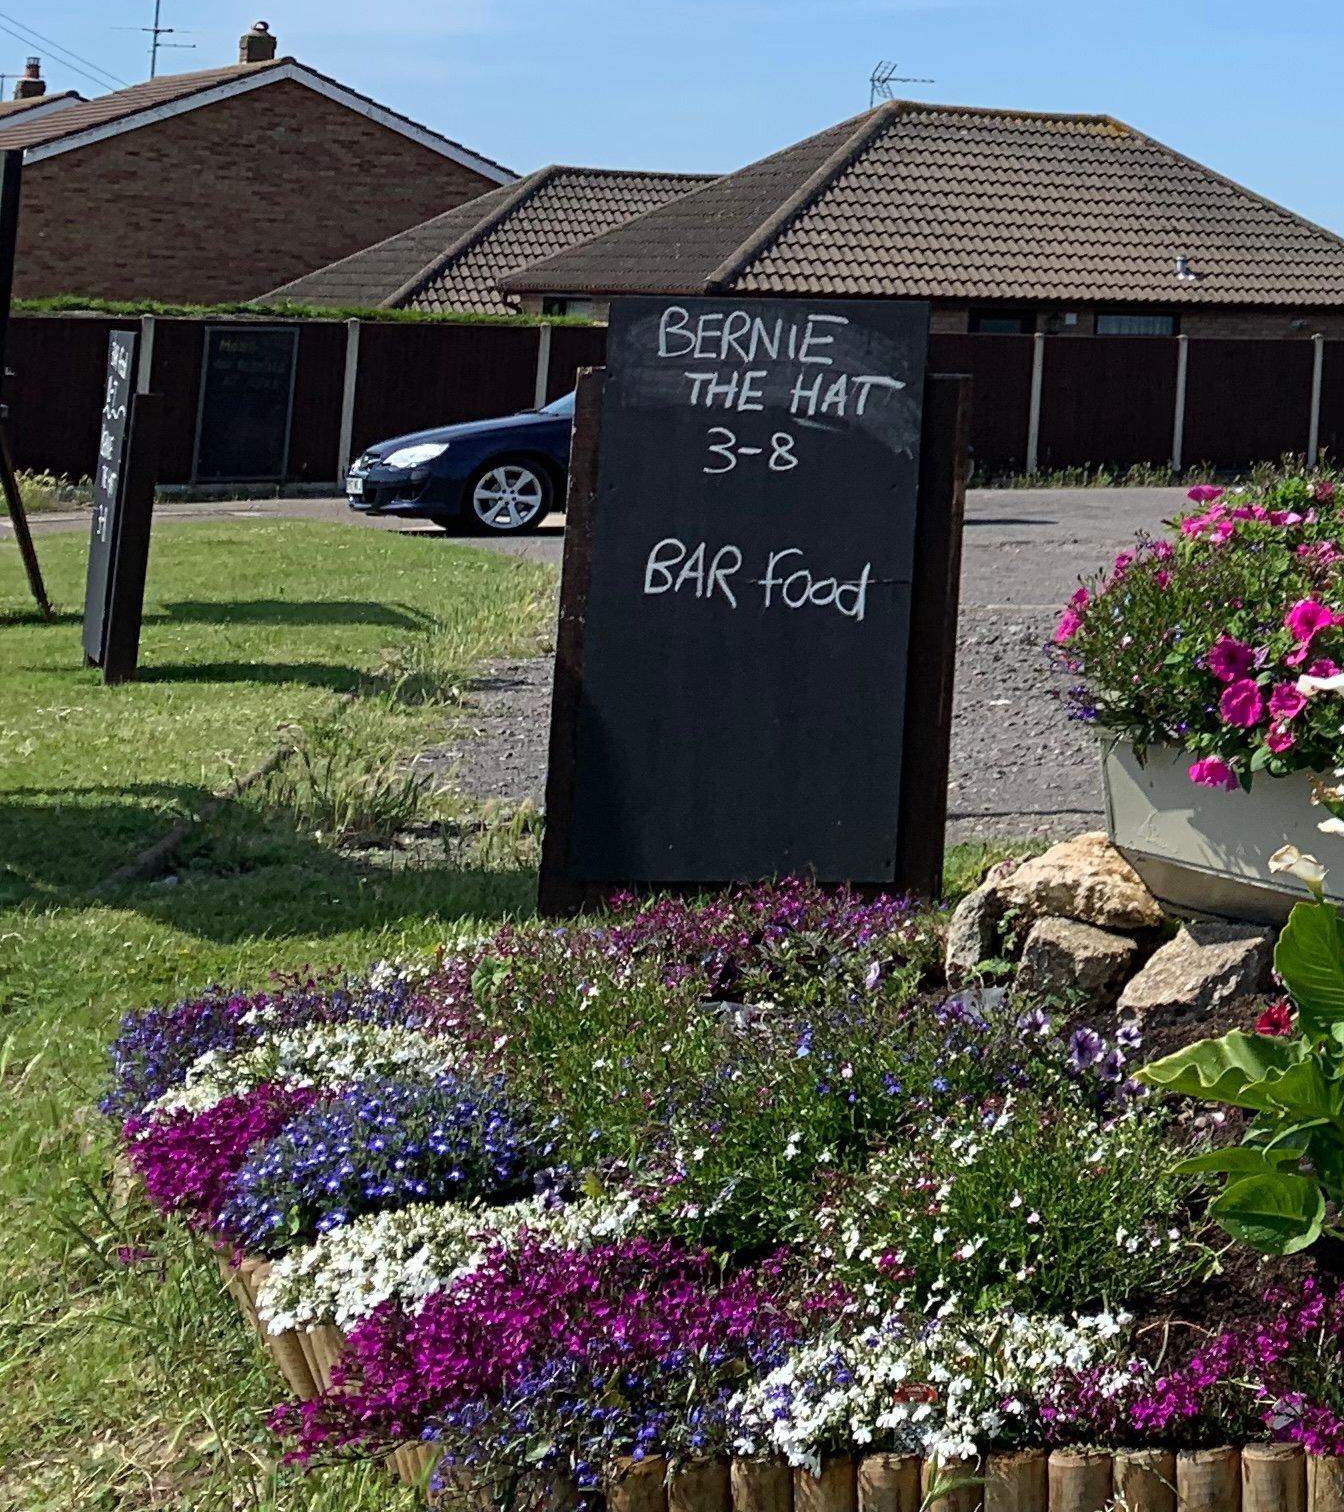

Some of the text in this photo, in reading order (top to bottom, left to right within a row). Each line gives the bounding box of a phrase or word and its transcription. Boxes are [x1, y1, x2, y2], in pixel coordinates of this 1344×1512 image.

[657, 305, 850, 364] BERNIE
[684, 370, 907, 417] THE HAT
[702, 426, 799, 474] 3-8
[643, 537, 743, 609] BAR
